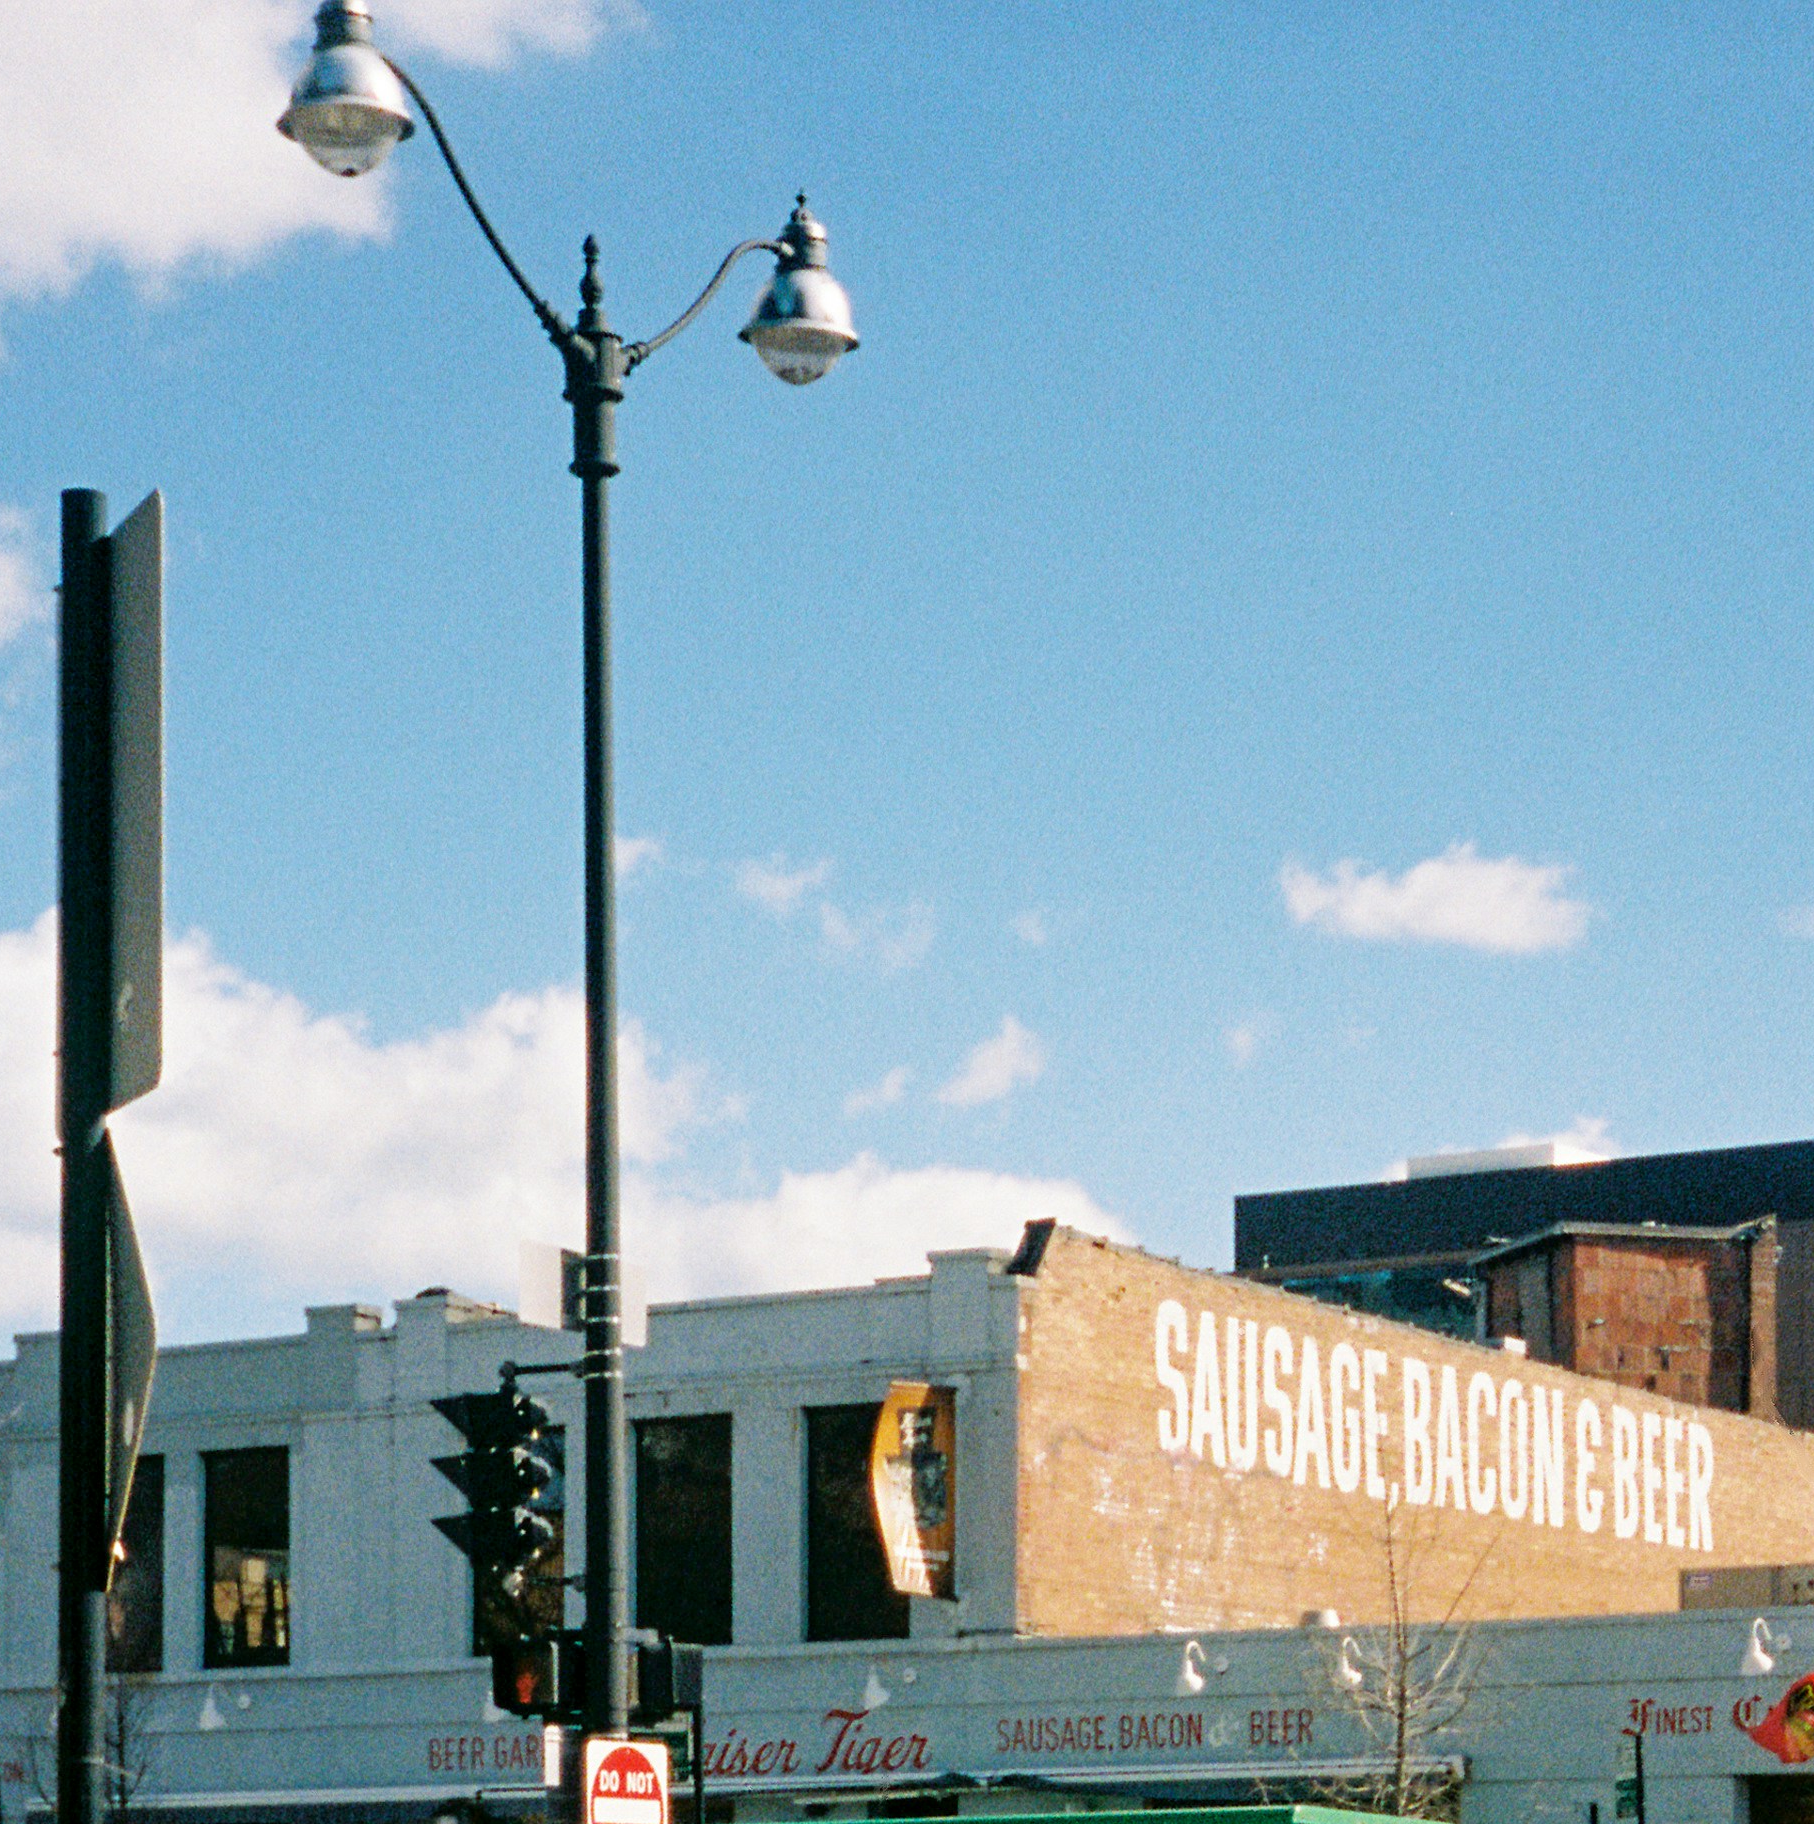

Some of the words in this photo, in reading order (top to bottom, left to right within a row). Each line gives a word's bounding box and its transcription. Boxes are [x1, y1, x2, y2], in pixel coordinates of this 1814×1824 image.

[1402, 1356, 1565, 1529] BACON
[1575, 1397, 1604, 1534] &
[1612, 1404, 1715, 1553] BEER
[702, 1728, 802, 1777] aiser
[815, 1708, 933, 1775] Tiger
[1118, 1711, 1203, 1749] BACON
[1248, 1708, 1314, 1745] BEER
[427, 1737, 485, 1771] BEER
[493, 1736, 544, 1769] GAR
[598, 1769, 619, 1792] DO
[625, 1771, 655, 1794] NOT
